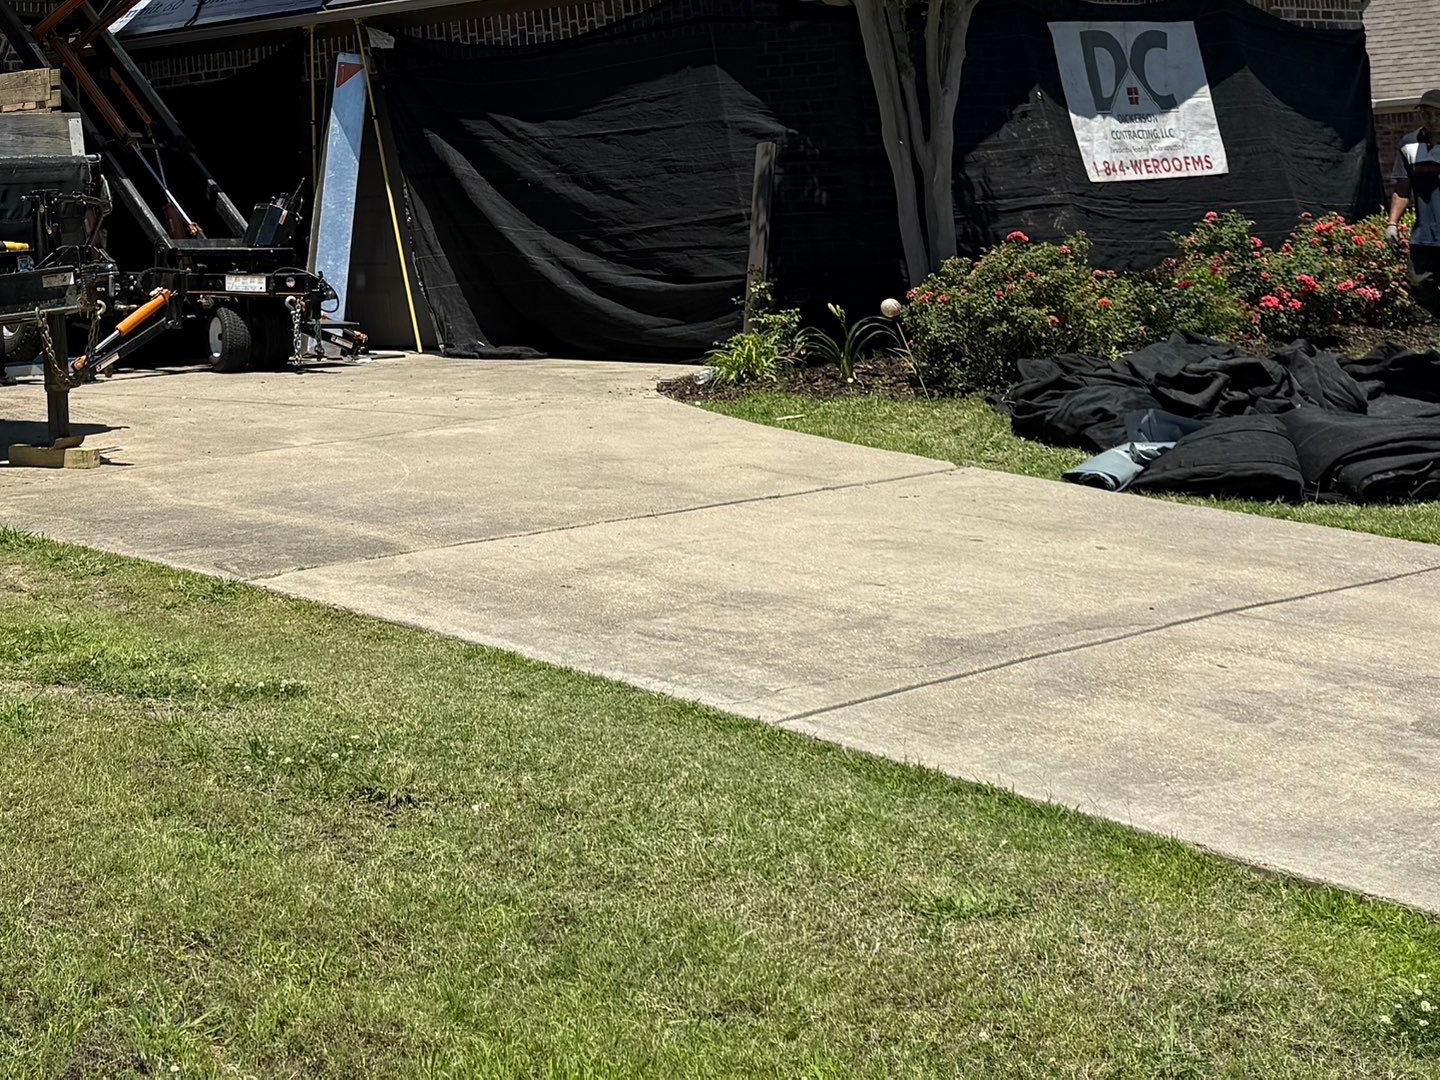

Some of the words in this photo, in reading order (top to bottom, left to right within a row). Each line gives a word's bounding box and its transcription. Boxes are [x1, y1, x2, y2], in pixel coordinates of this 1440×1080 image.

[1080, 29, 1179, 112] DC
[1116, 113, 1160, 124] DICKERSON
[1160, 127, 1175, 138] LLC
